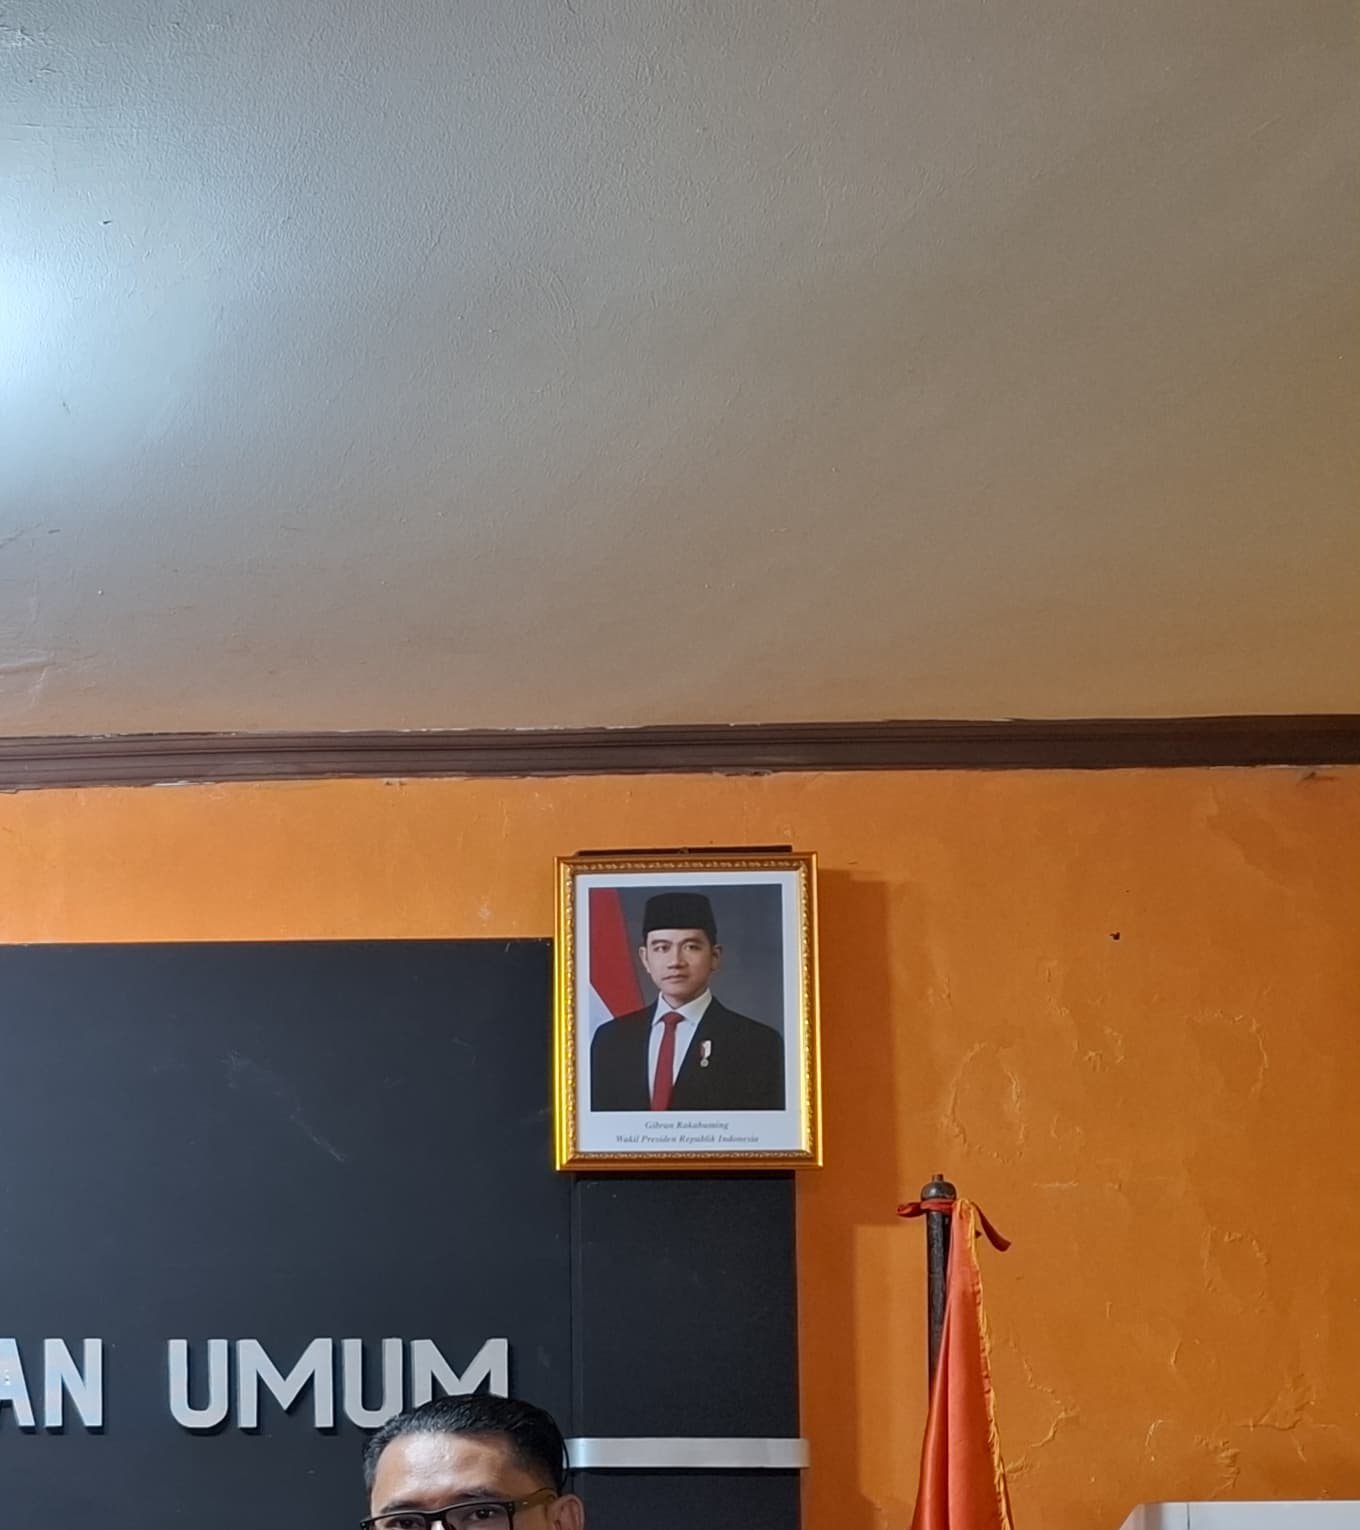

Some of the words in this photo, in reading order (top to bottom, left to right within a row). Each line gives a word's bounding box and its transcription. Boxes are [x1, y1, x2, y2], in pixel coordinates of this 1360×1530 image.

[640, 1135, 677, 1143] Presiden
[680, 1134, 715, 1144] Republik
[718, 1135, 760, 1143] Indonesia
[167, 1338, 509, 1428] UMUM
